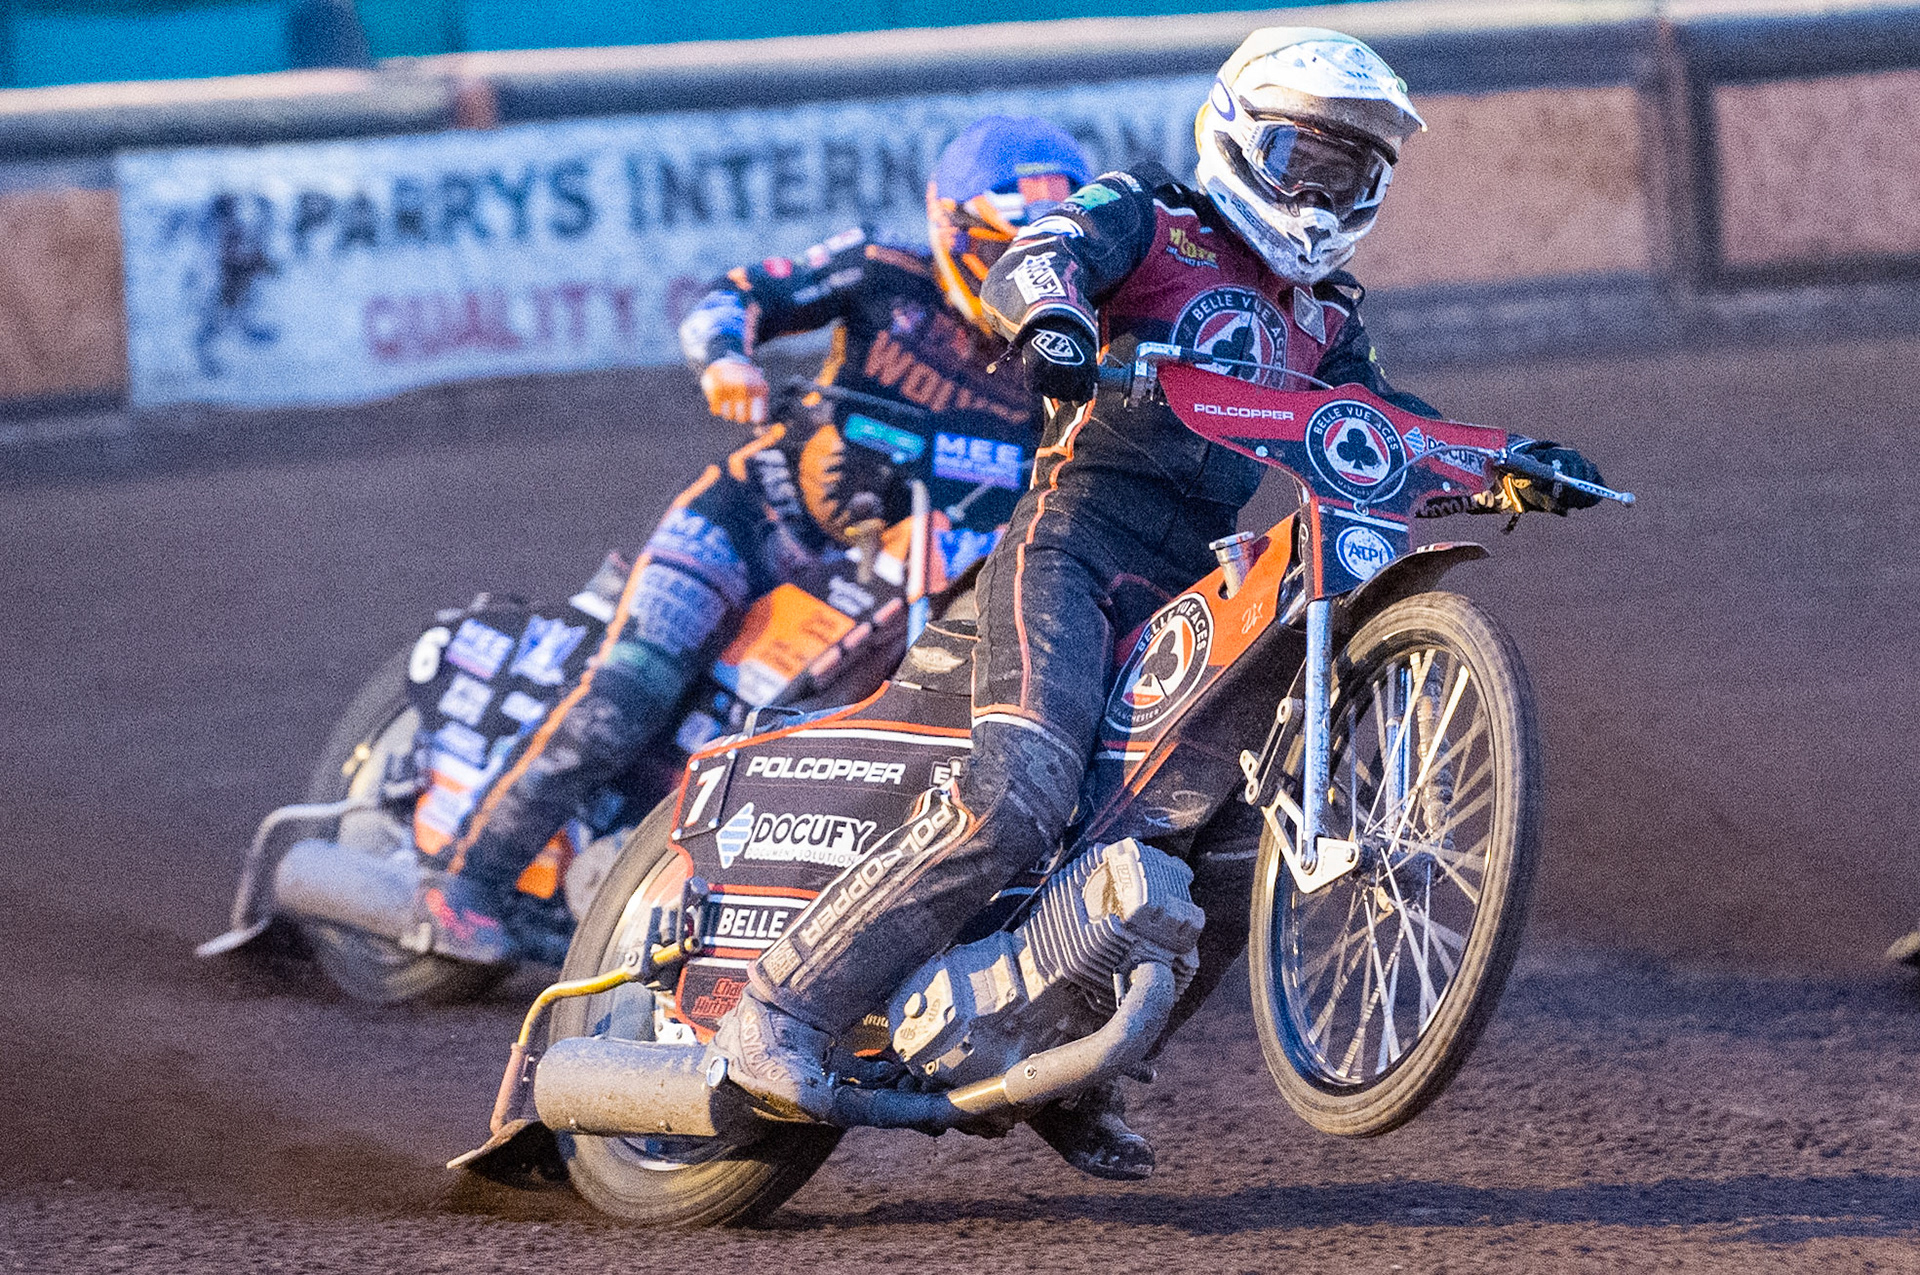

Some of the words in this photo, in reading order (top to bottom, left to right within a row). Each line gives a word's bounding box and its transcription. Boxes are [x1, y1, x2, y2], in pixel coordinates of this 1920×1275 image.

[293, 160, 597, 258] PARRYS
[363, 281, 636, 361] QUALITY
[1191, 294, 1234, 321] BELLE
[1242, 296, 1272, 322] VUE
[1194, 403, 1295, 422] POLCOPPER
[1313, 408, 1342, 436] BELLE
[1346, 407, 1371, 421] VUE
[1374, 420, 1399, 452] ACES
[1137, 610, 1175, 652] BELLE
[1176, 601, 1195, 618] VUE
[1190, 613, 1208, 651] ACES
[746, 756, 906, 785] POLCOPPER
[684, 765, 725, 828] 1
[753, 816, 875, 852] DOCUFY
[801, 802, 957, 949] POLCOPPER
[717, 907, 789, 939] BELLE
